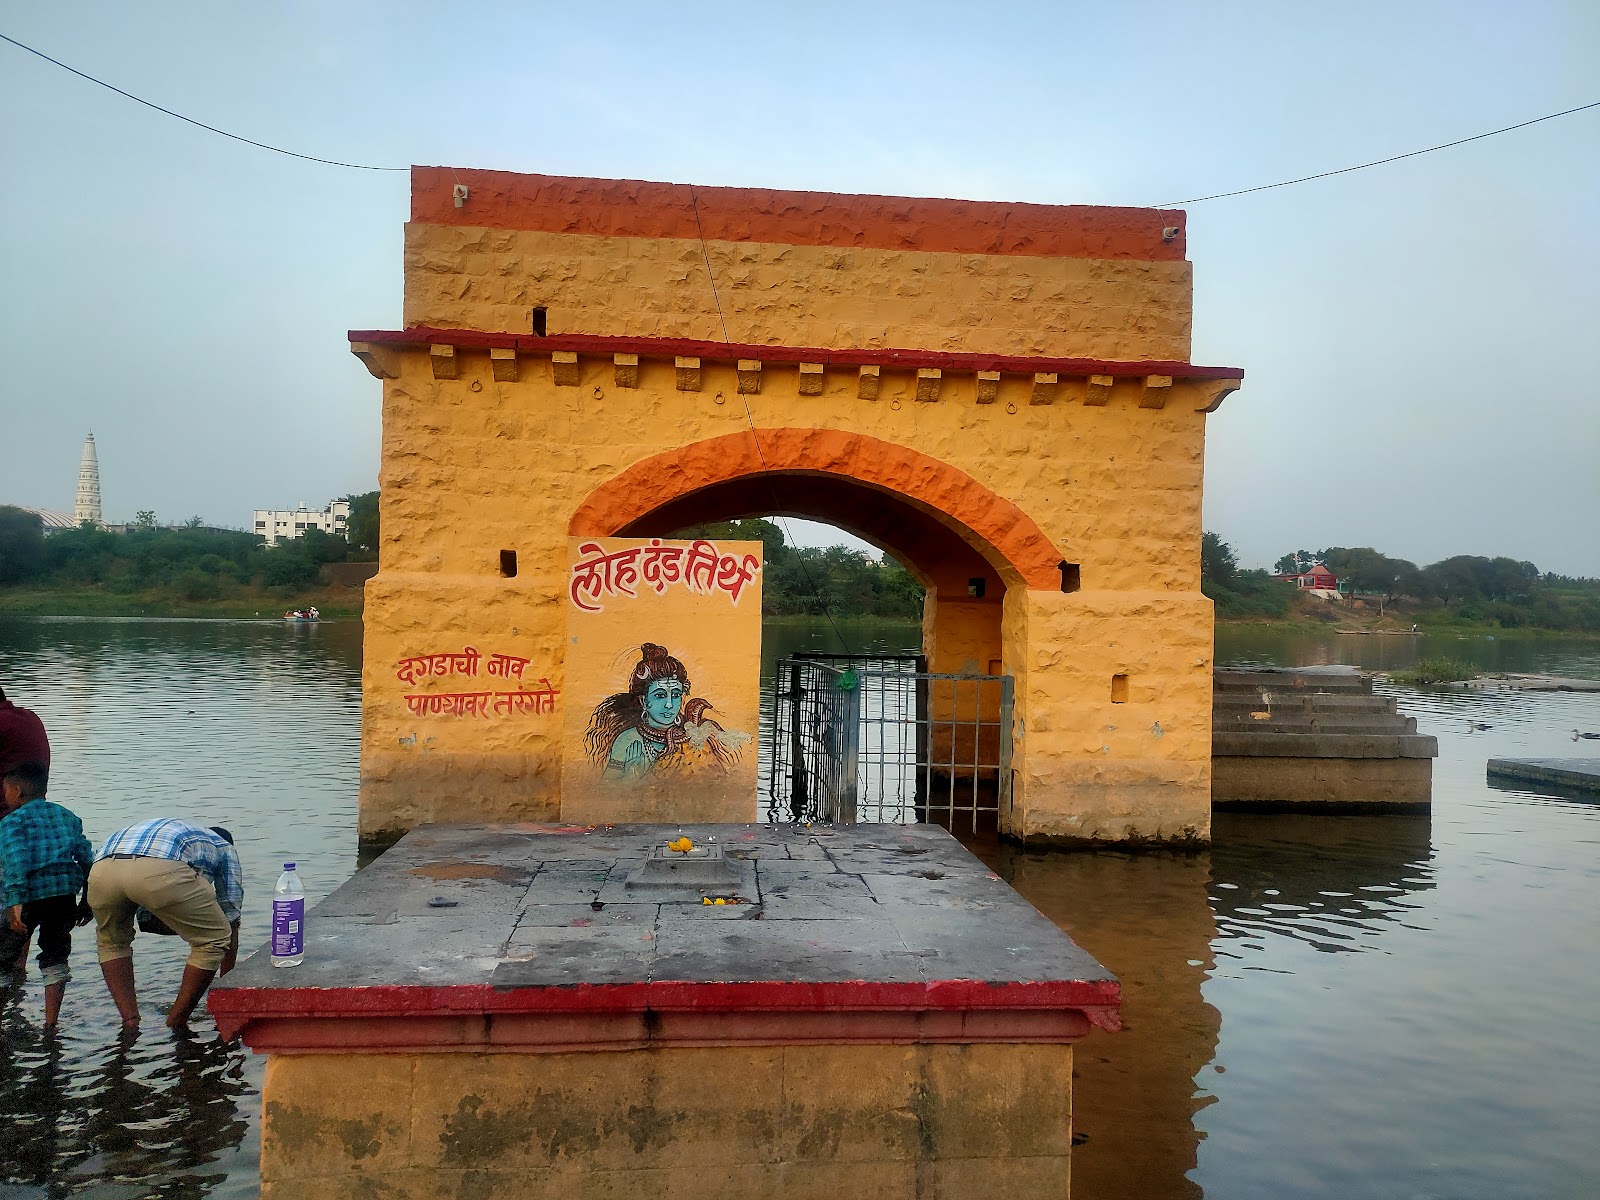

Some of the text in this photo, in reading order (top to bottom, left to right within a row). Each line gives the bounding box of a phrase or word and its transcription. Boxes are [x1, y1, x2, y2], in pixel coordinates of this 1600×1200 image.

[396, 646, 532, 686] दगडाची नाव
[403, 677, 561, 720] पाण्यावर तरंगते
